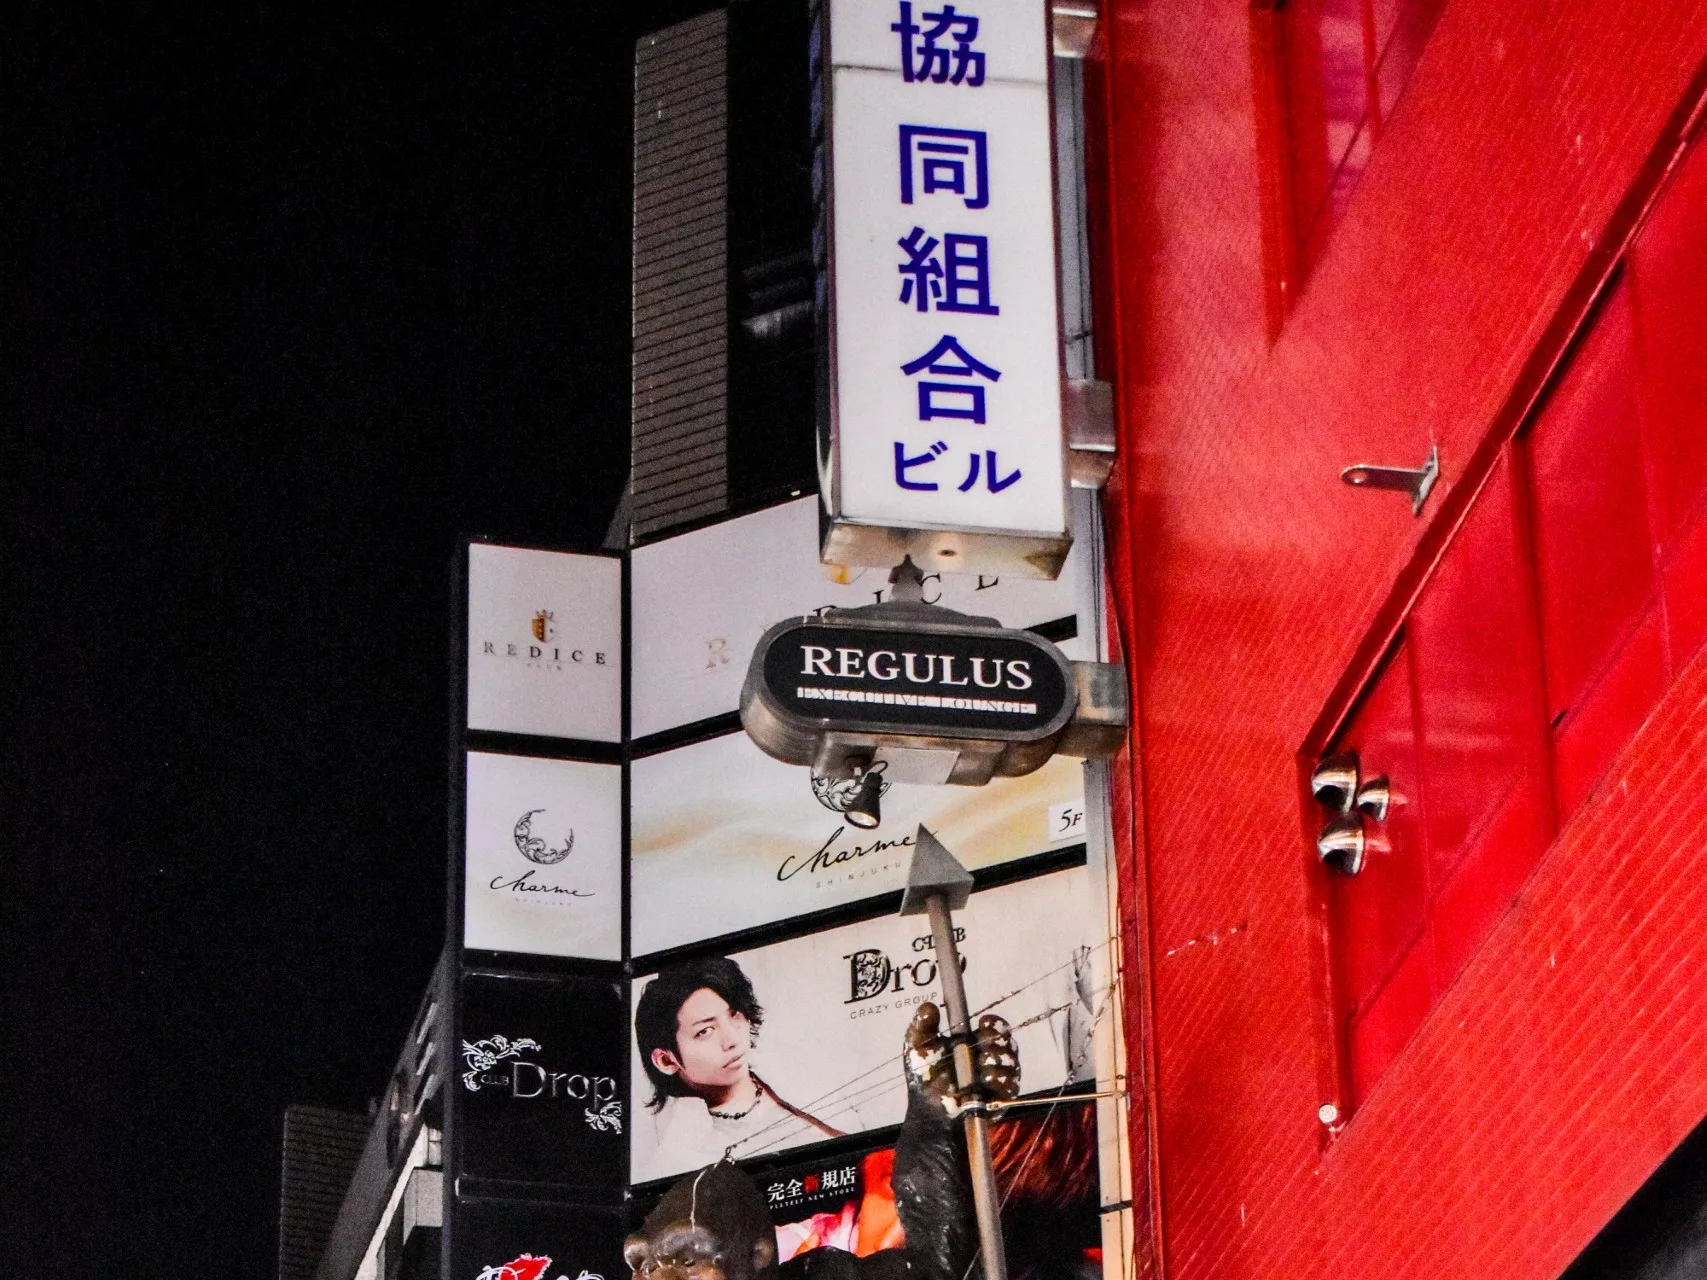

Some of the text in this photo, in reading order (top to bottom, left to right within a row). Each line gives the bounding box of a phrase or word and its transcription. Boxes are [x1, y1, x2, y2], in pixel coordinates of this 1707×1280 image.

[483, 640, 606, 665] REDICE
[799, 645, 1033, 691] REGULUS
[1059, 808, 1083, 833] 5F
[489, 869, 596, 898] Charme
[911, 926, 967, 953] CLB
[849, 991, 939, 1020] CRAZY GROUP
[512, 1061, 617, 1111] Drop
